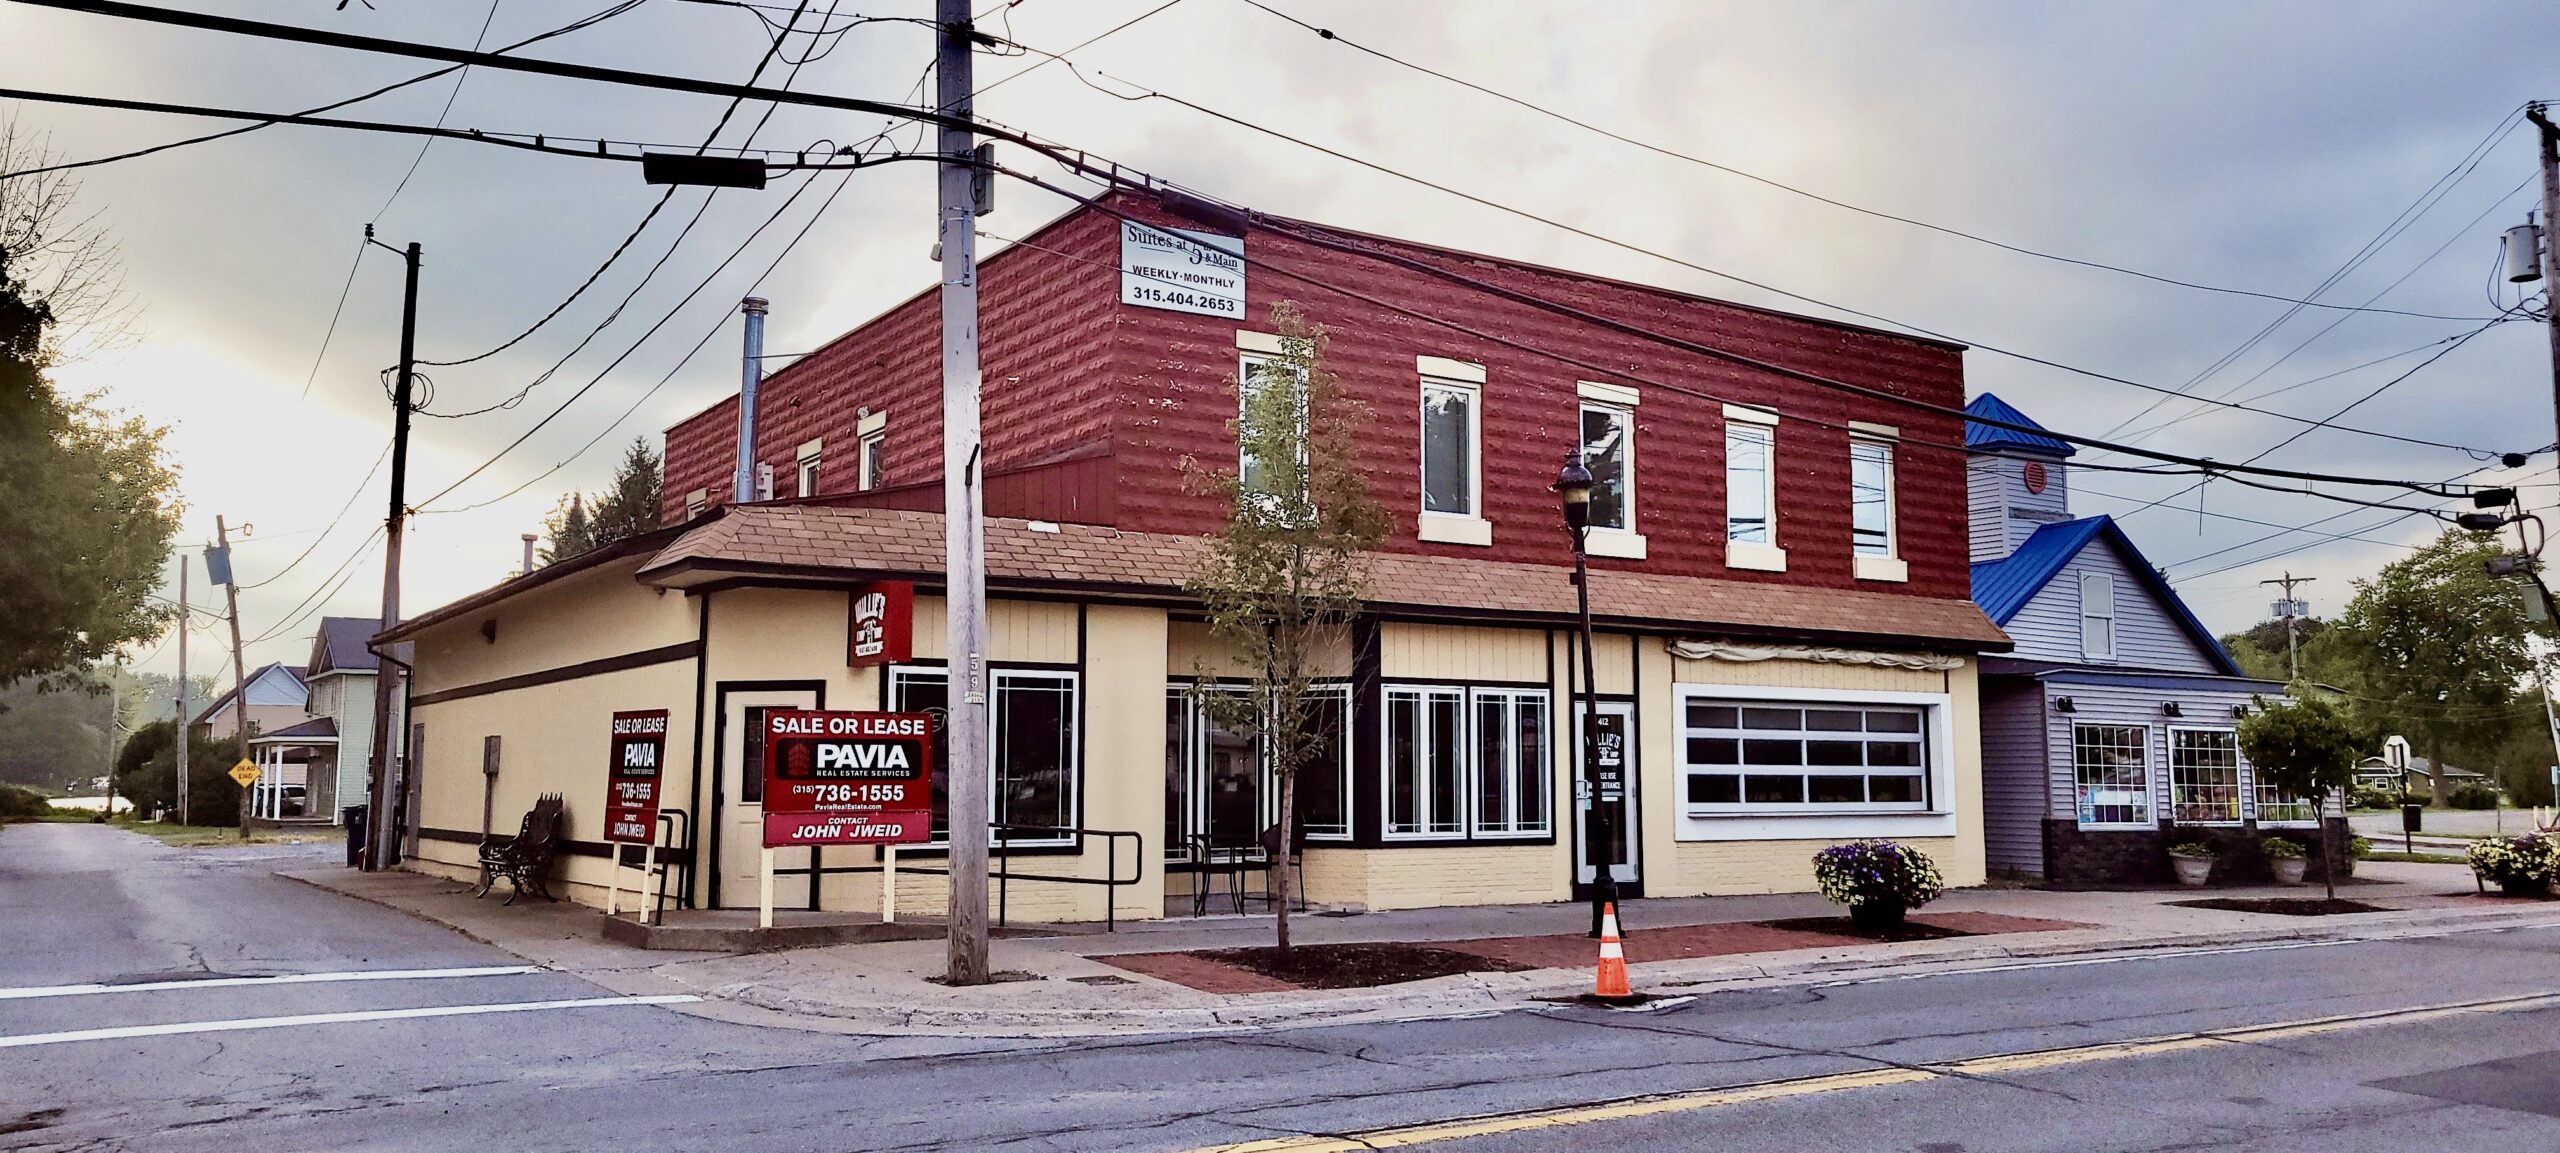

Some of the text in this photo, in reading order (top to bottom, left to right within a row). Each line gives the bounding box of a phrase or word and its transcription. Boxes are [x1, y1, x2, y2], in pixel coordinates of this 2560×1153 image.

[1128, 226, 1172, 248] Suites
[1176, 241, 1188, 251] at
[1133, 286, 1235, 312] 315.404.2653
[614, 717, 665, 734] SALE OR LEASE
[772, 717, 925, 735] SALE OR LEASE
[624, 743, 655, 767] PAVIA
[817, 743, 909, 769] PAVIA
[621, 782, 651, 800] 736-1555
[613, 822, 629, 836] JOHN
[828, 817, 869, 825] CONTACT
[792, 825, 903, 839] JOHN JWEID
